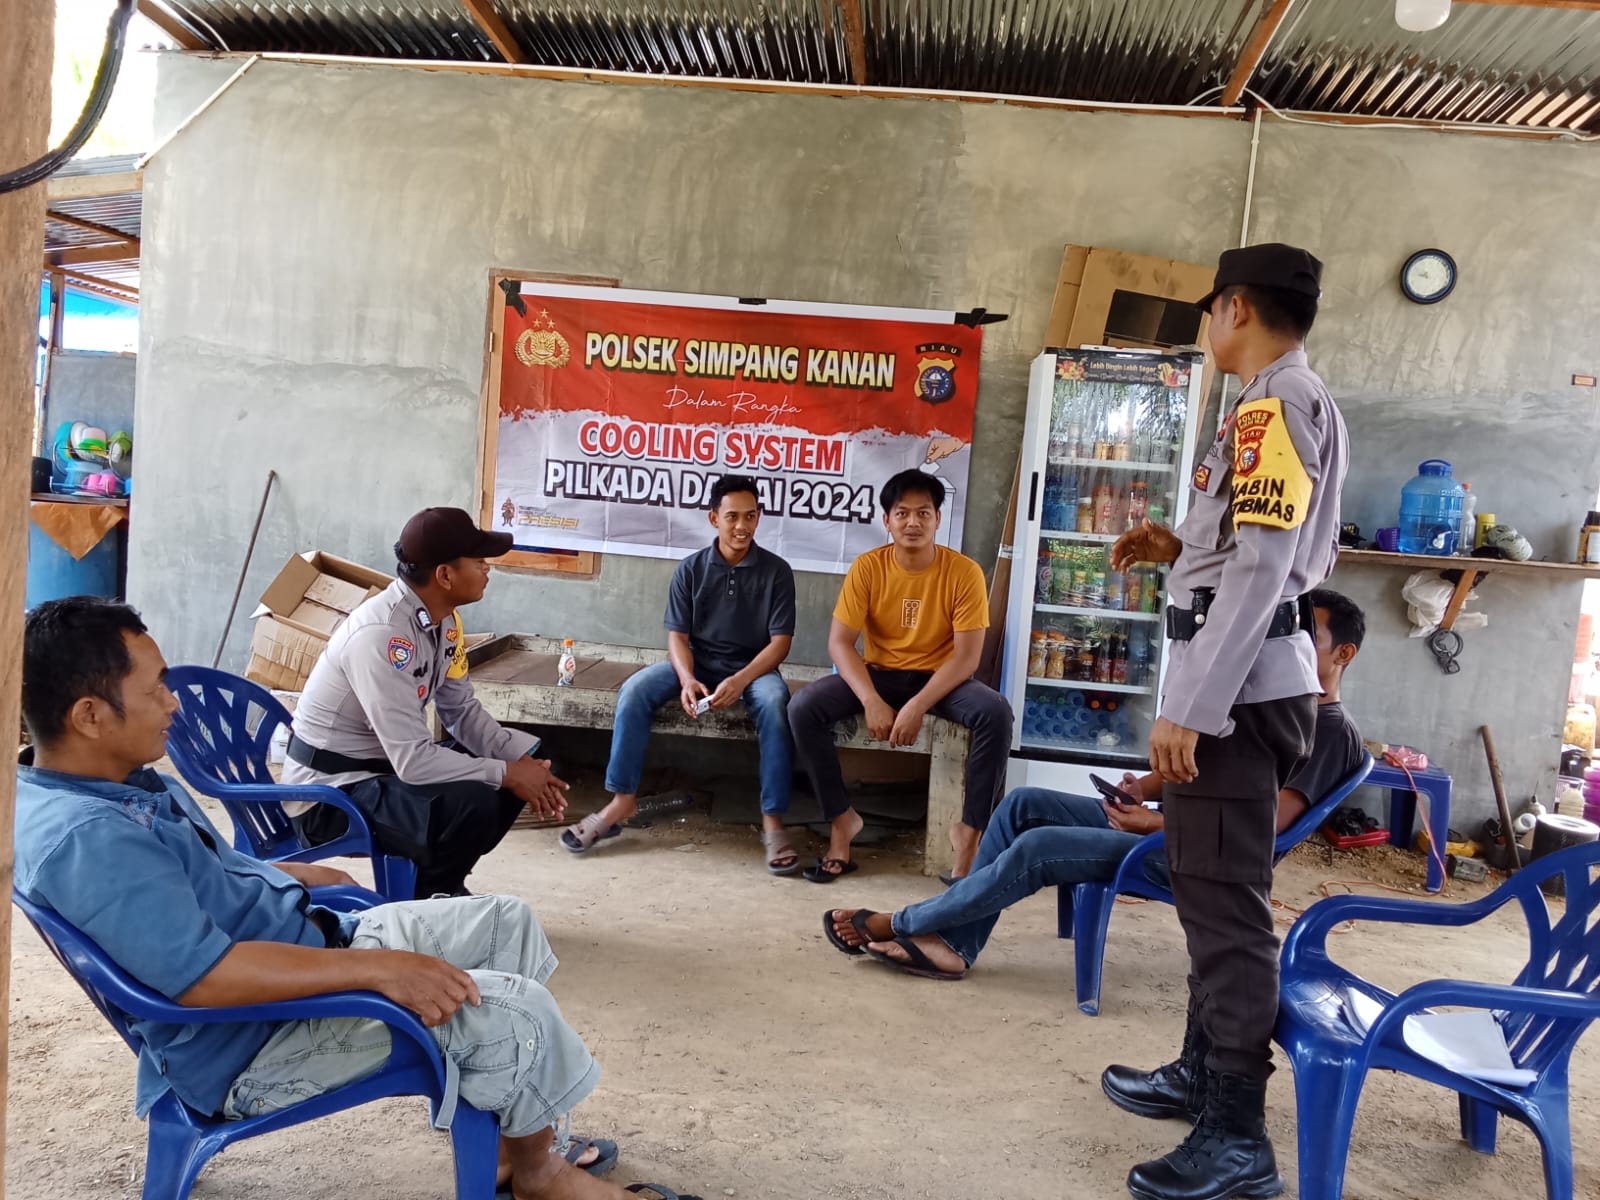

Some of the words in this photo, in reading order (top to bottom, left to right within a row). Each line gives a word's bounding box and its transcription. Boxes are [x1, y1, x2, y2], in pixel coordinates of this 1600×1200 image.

[585, 331, 679, 374] POLSEK
[684, 339, 799, 383] SIMPANG
[805, 347, 896, 390] KANAN
[920, 344, 958, 354] RIAU
[663, 384, 727, 409] Dalam
[727, 391, 802, 424] Rangka
[579, 419, 718, 465] COOLING
[724, 431, 845, 473] SYSTEM
[545, 460, 674, 506] PILKADA
[680, 471, 785, 515] DAAI
[790, 480, 875, 523] 2024
